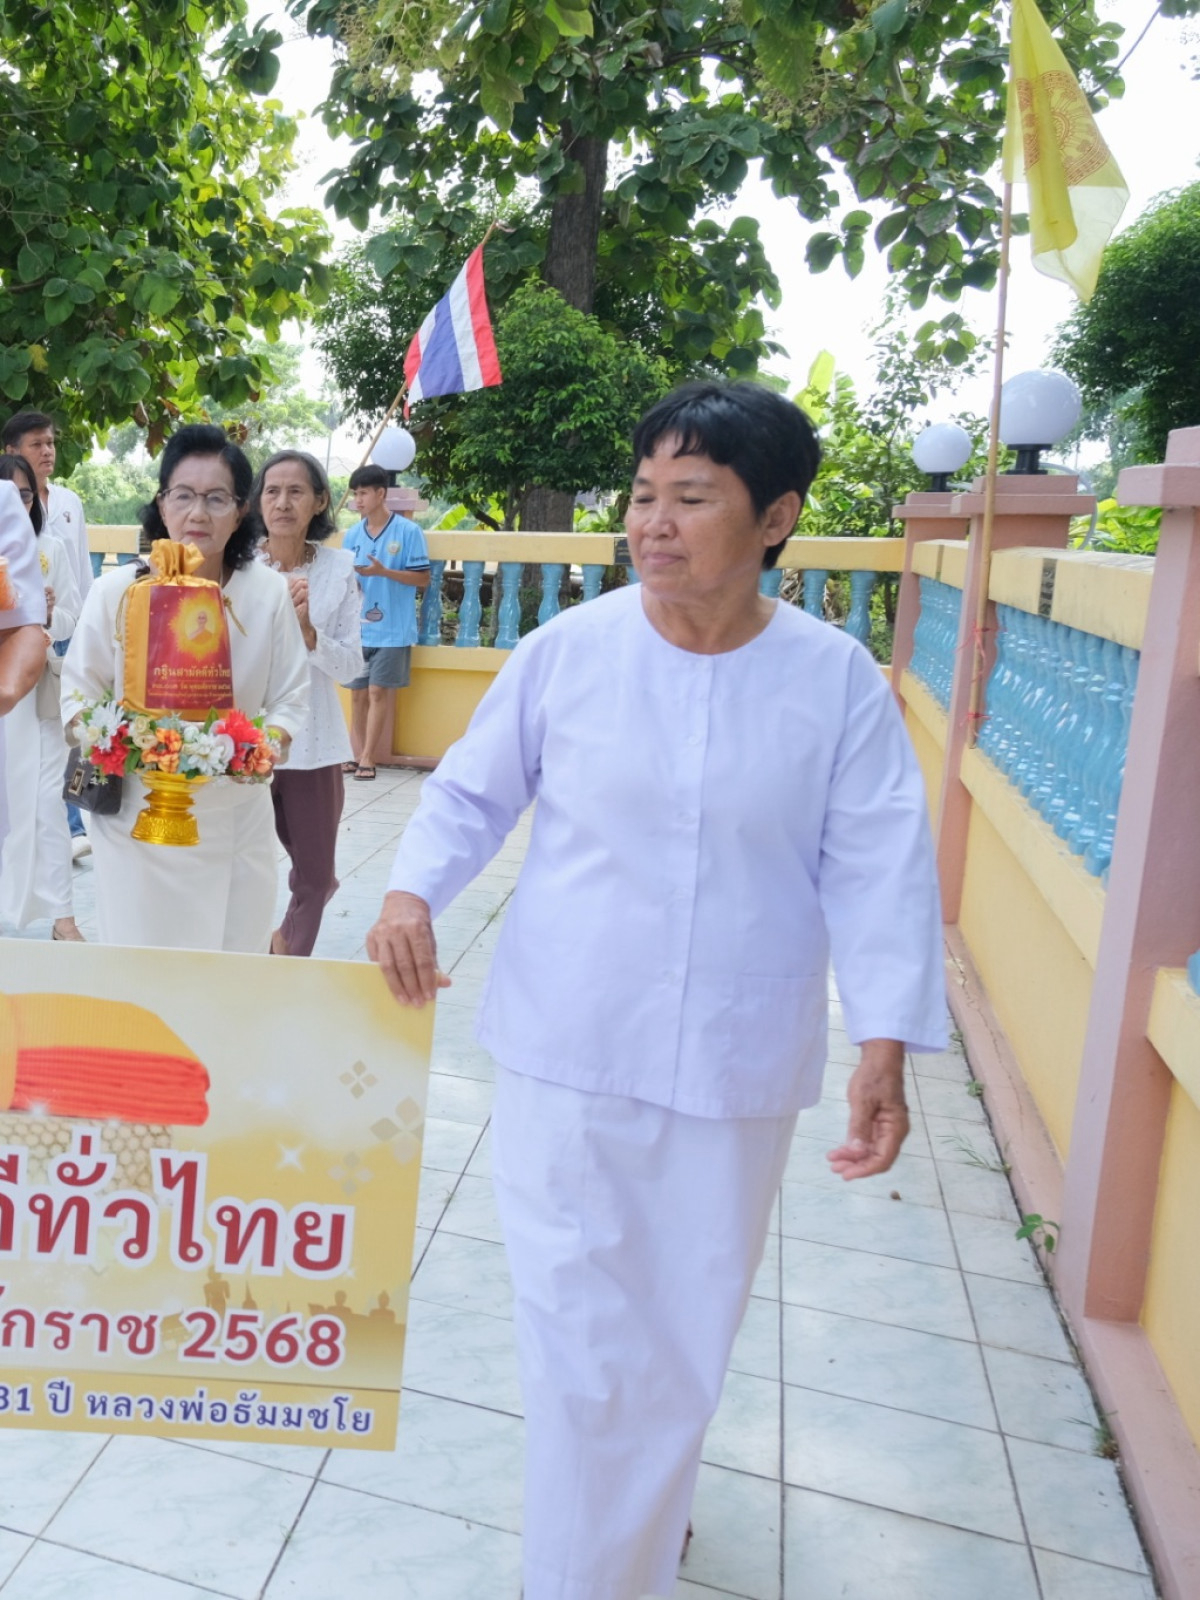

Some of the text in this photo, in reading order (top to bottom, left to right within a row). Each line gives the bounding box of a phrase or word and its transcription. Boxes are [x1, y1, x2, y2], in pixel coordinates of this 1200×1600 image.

[183, 1311, 346, 1367] 2568
[48, 1381, 71, 1414] ปี
[87, 1391, 371, 1432] หลวงพ่อธัมมชโย
